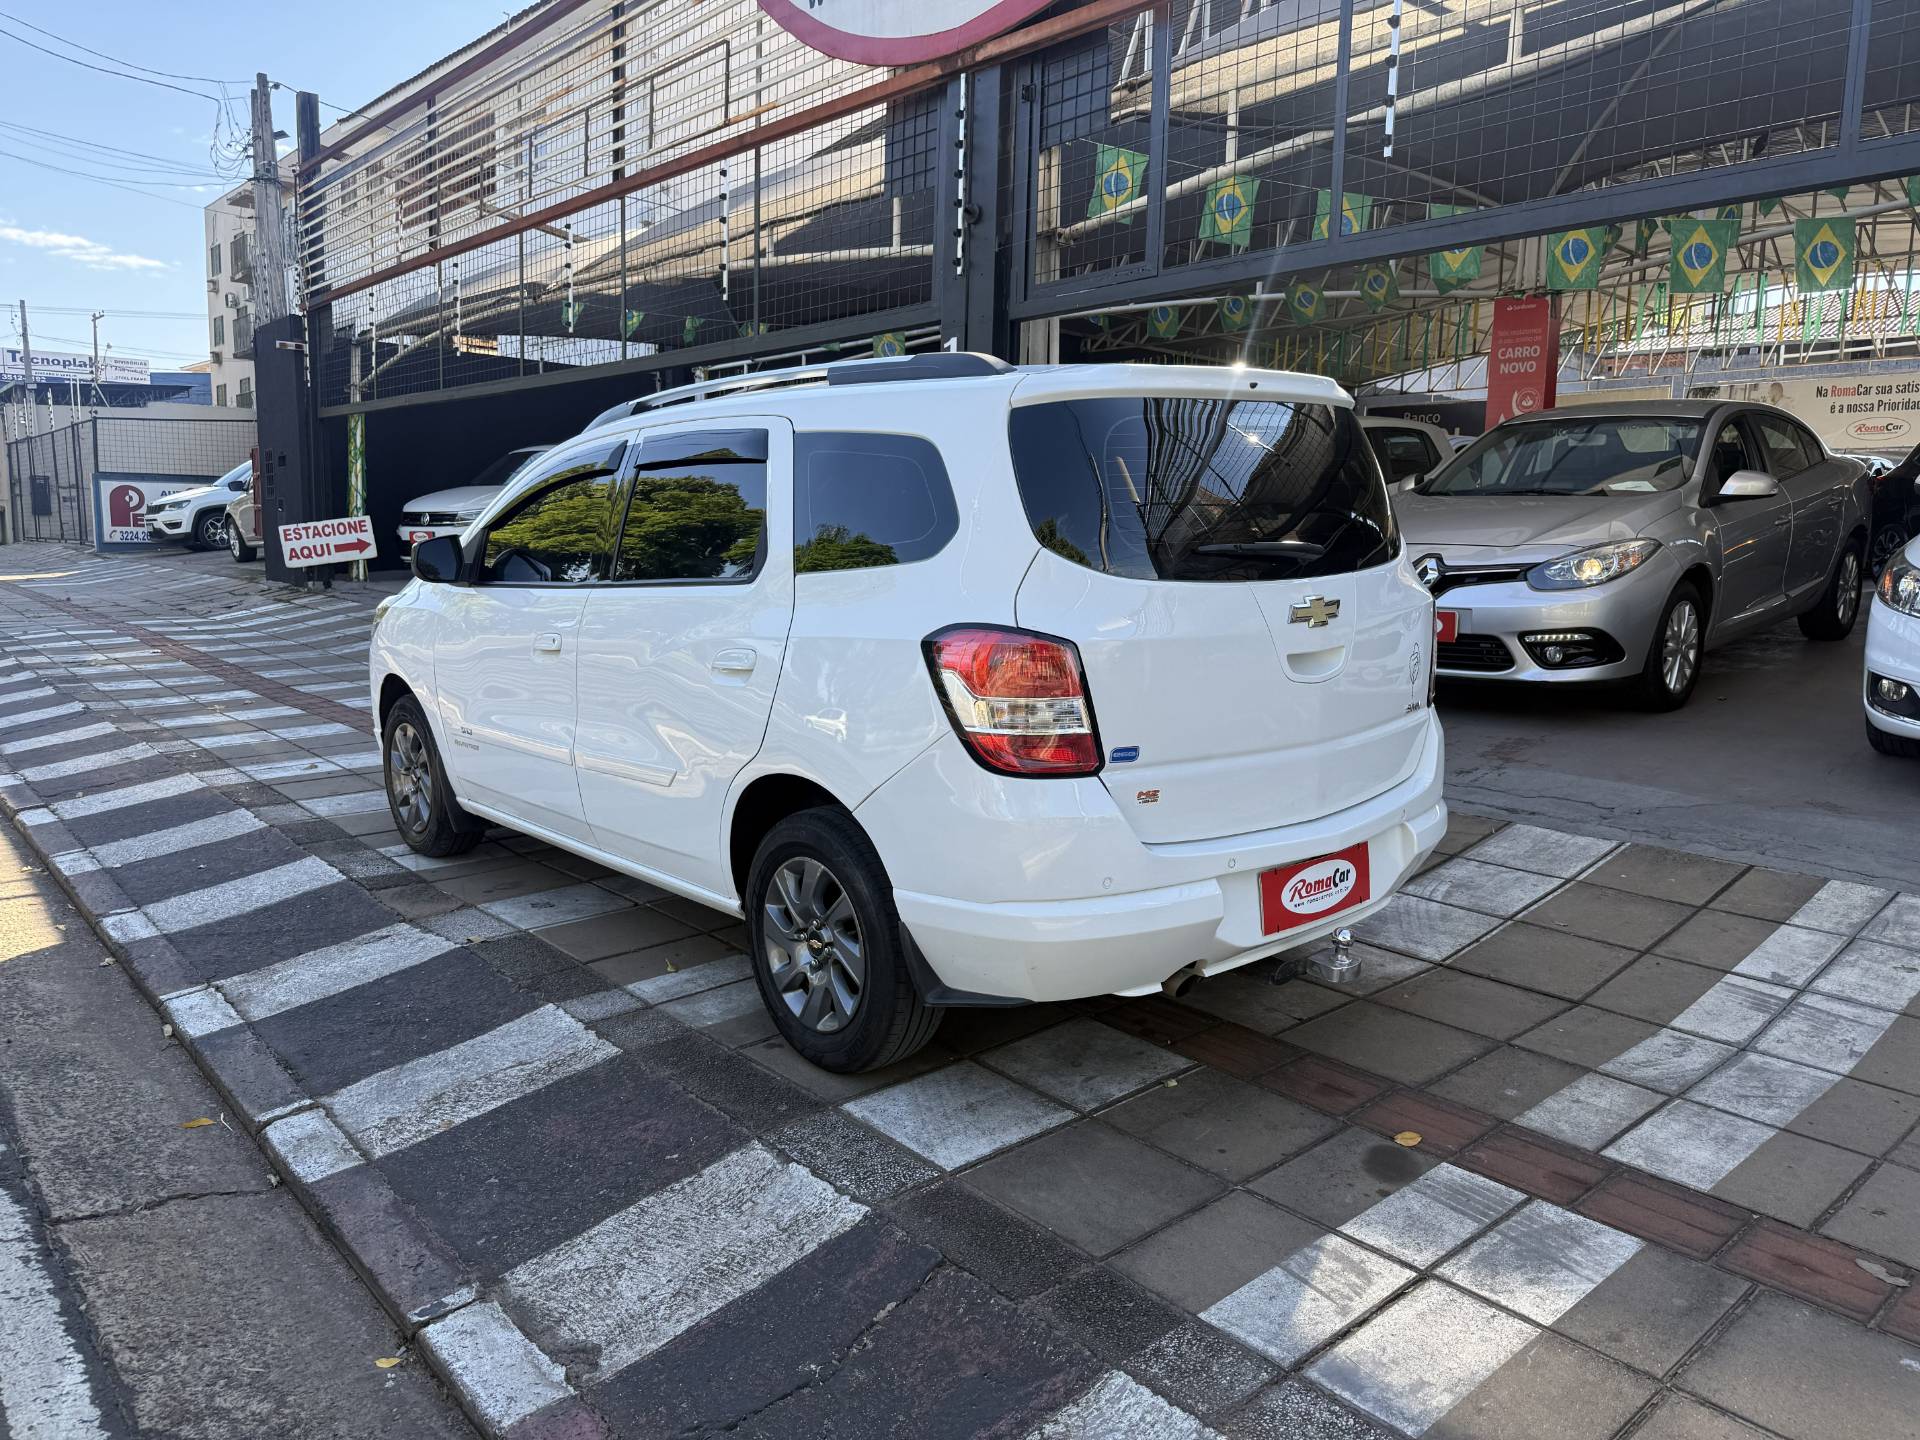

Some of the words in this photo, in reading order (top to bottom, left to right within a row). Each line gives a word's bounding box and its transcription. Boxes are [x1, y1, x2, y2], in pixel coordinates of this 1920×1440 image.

[1498, 345, 1541, 360] CARRO
[1500, 361, 1536, 374] NOVO
[1816, 386, 1828, 398] Na
[1831, 384, 1873, 397] RomaCar
[1875, 385, 1892, 395] sua
[1895, 380, 1920, 394] satis
[1830, 402, 1836, 414] é
[1838, 405, 1844, 413] a
[1846, 402, 1874, 413] nossa
[1403, 412, 1440, 424] Banco
[1855, 423, 1903, 433] RomaCar
[283, 520, 368, 541] ESTACIONE
[289, 543, 331, 561] AQUI
[1289, 868, 1350, 902] RomaCar
